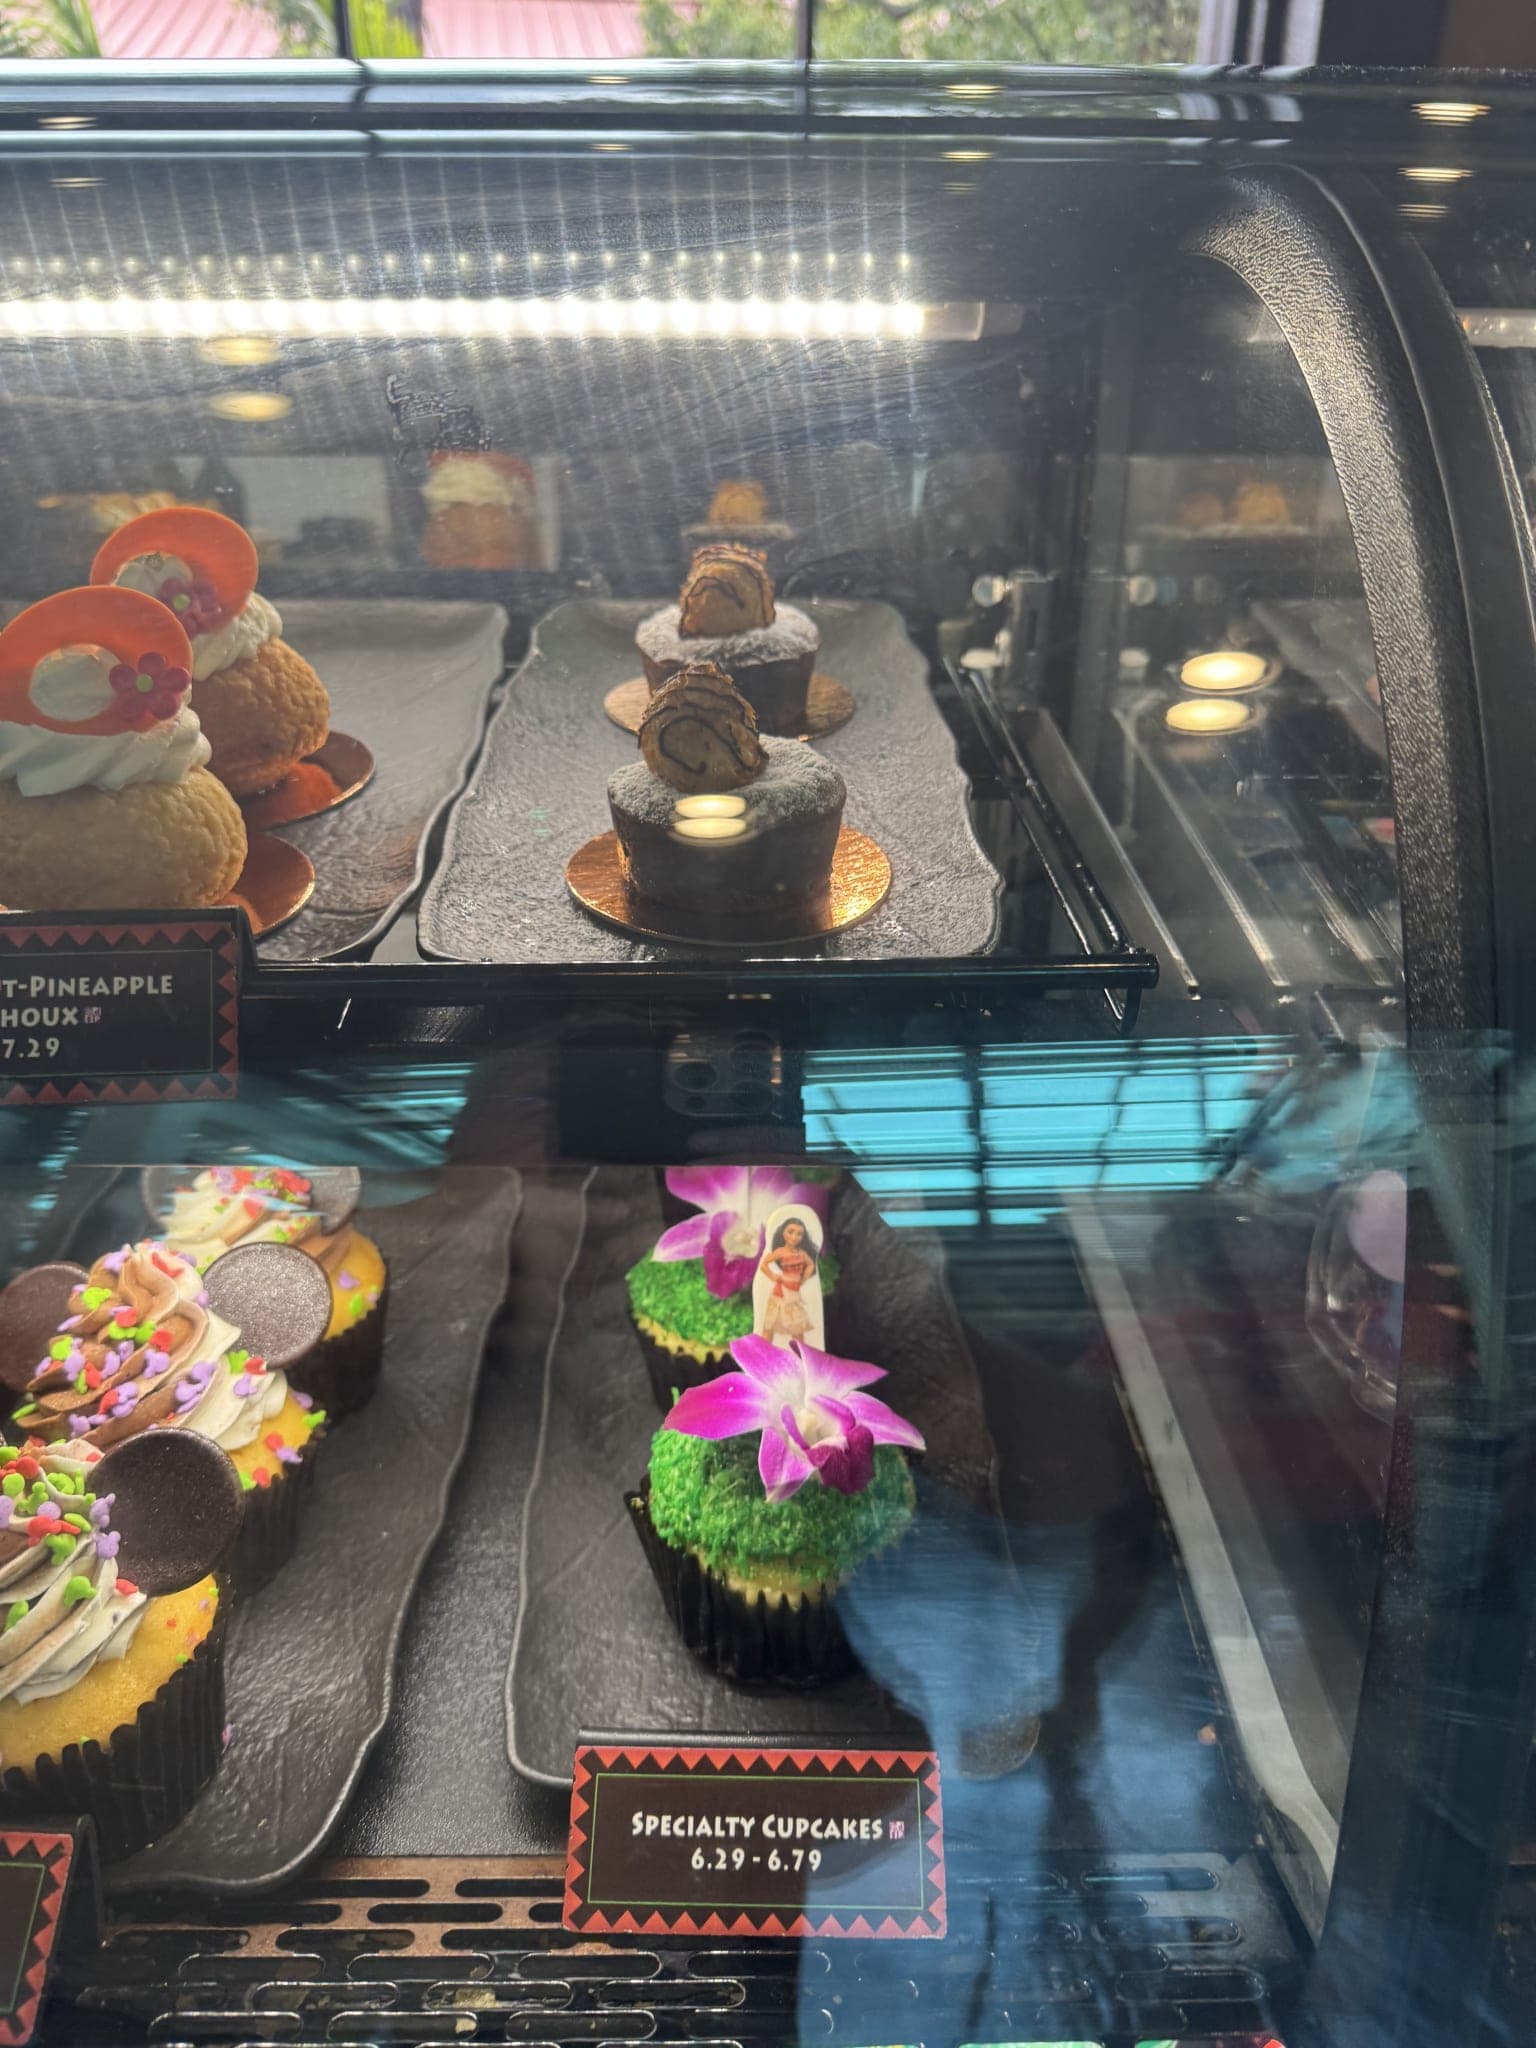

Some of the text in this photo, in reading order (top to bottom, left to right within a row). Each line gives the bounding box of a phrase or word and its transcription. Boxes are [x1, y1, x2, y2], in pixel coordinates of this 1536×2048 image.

[2, 975, 173, 998] T-PINEAPPLE
[0, 1007, 79, 1028] HOUX
[2, 1038, 60, 1059] 7.29
[631, 1811, 755, 1838] SPECIALTY
[762, 1814, 883, 1840] CUPCAKES
[691, 1848, 744, 1871] 6.29
[767, 1849, 821, 1872] 6.79
